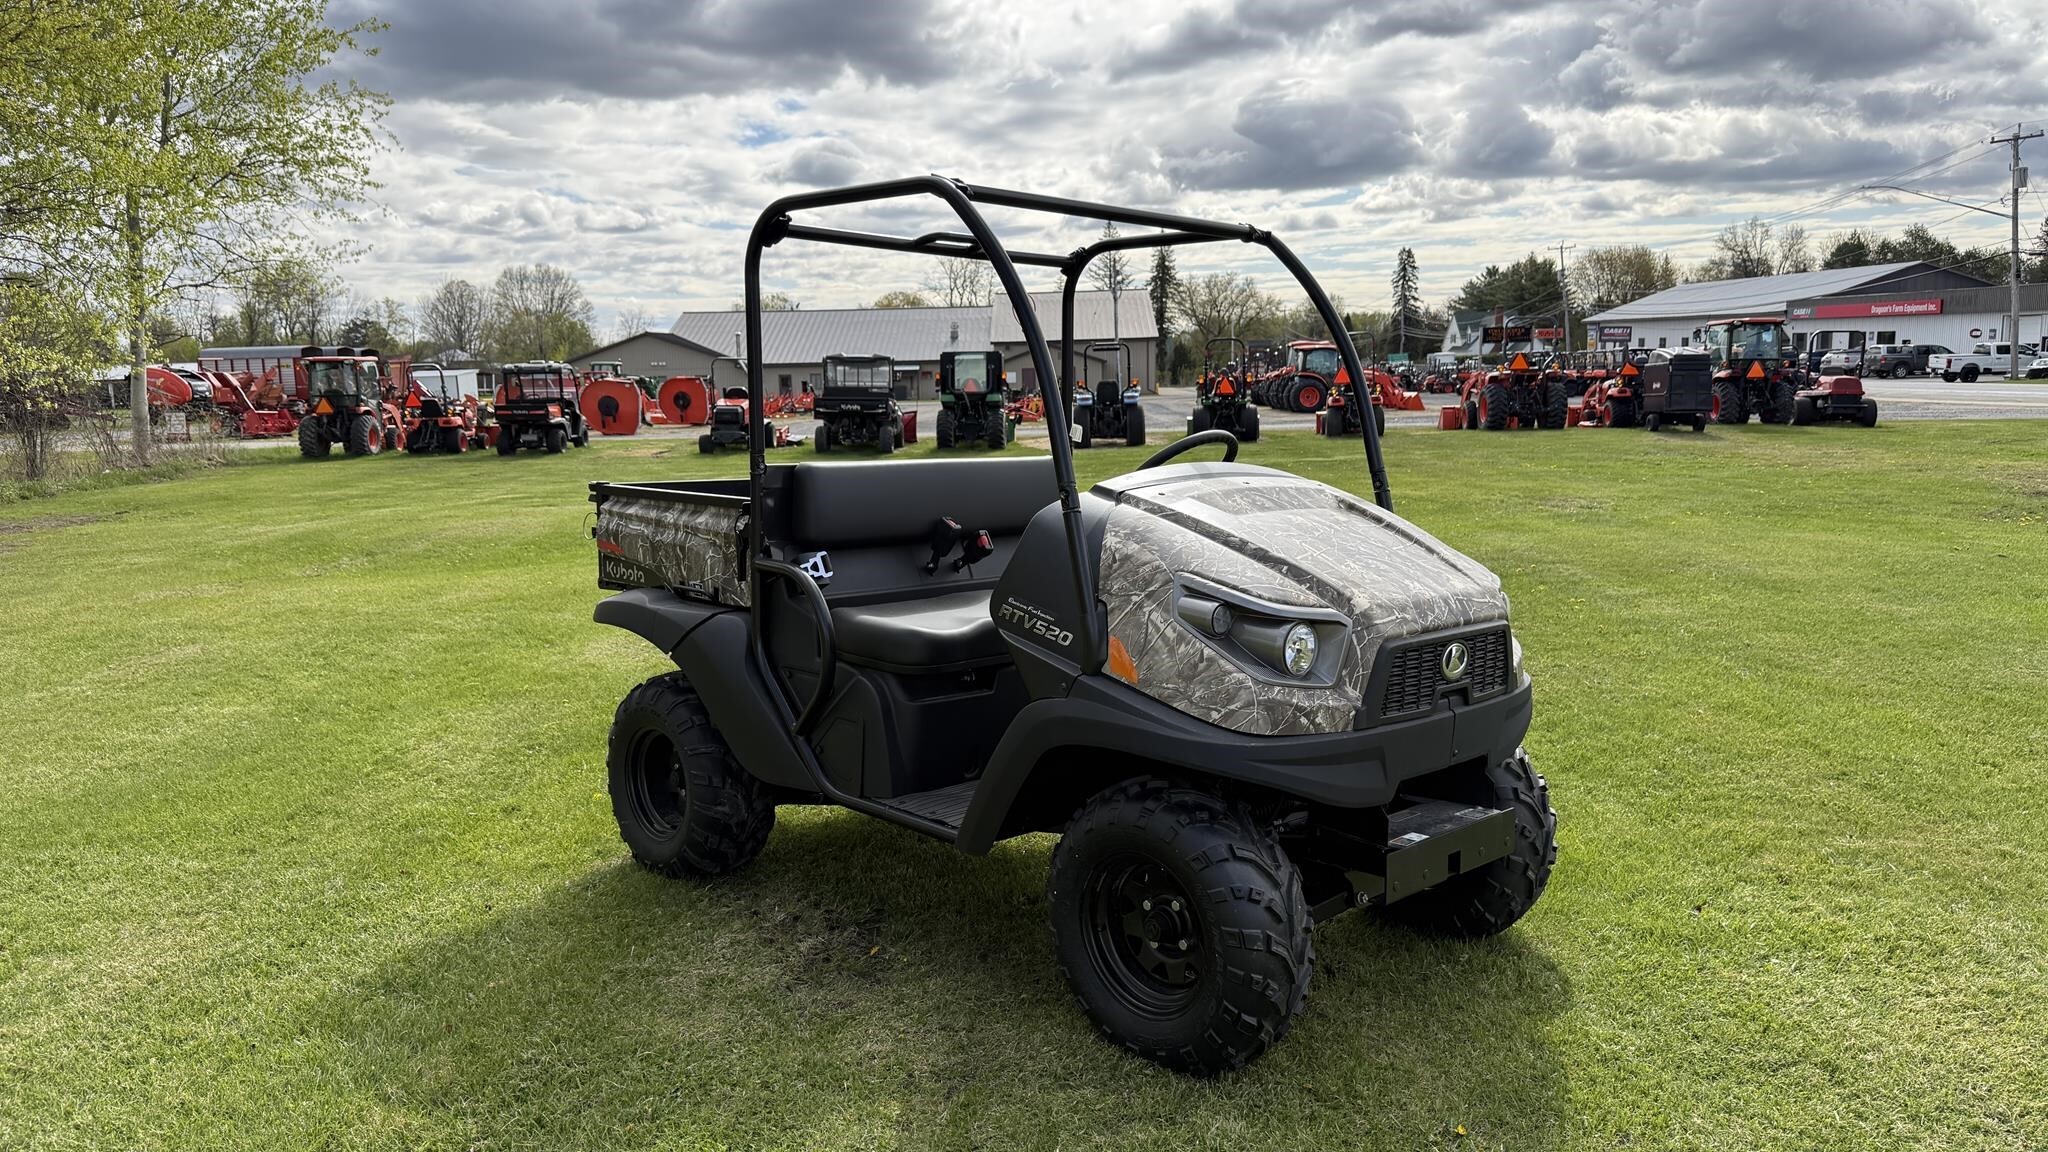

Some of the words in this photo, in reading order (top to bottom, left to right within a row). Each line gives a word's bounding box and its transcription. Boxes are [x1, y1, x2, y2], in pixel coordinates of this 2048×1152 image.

[1892, 304, 1904, 313] Farm
[1904, 303, 1928, 314] Equipment
[1928, 302, 1937, 311] Inc.
[606, 560, 645, 583] Kubota
[998, 603, 1074, 646] RTV520
